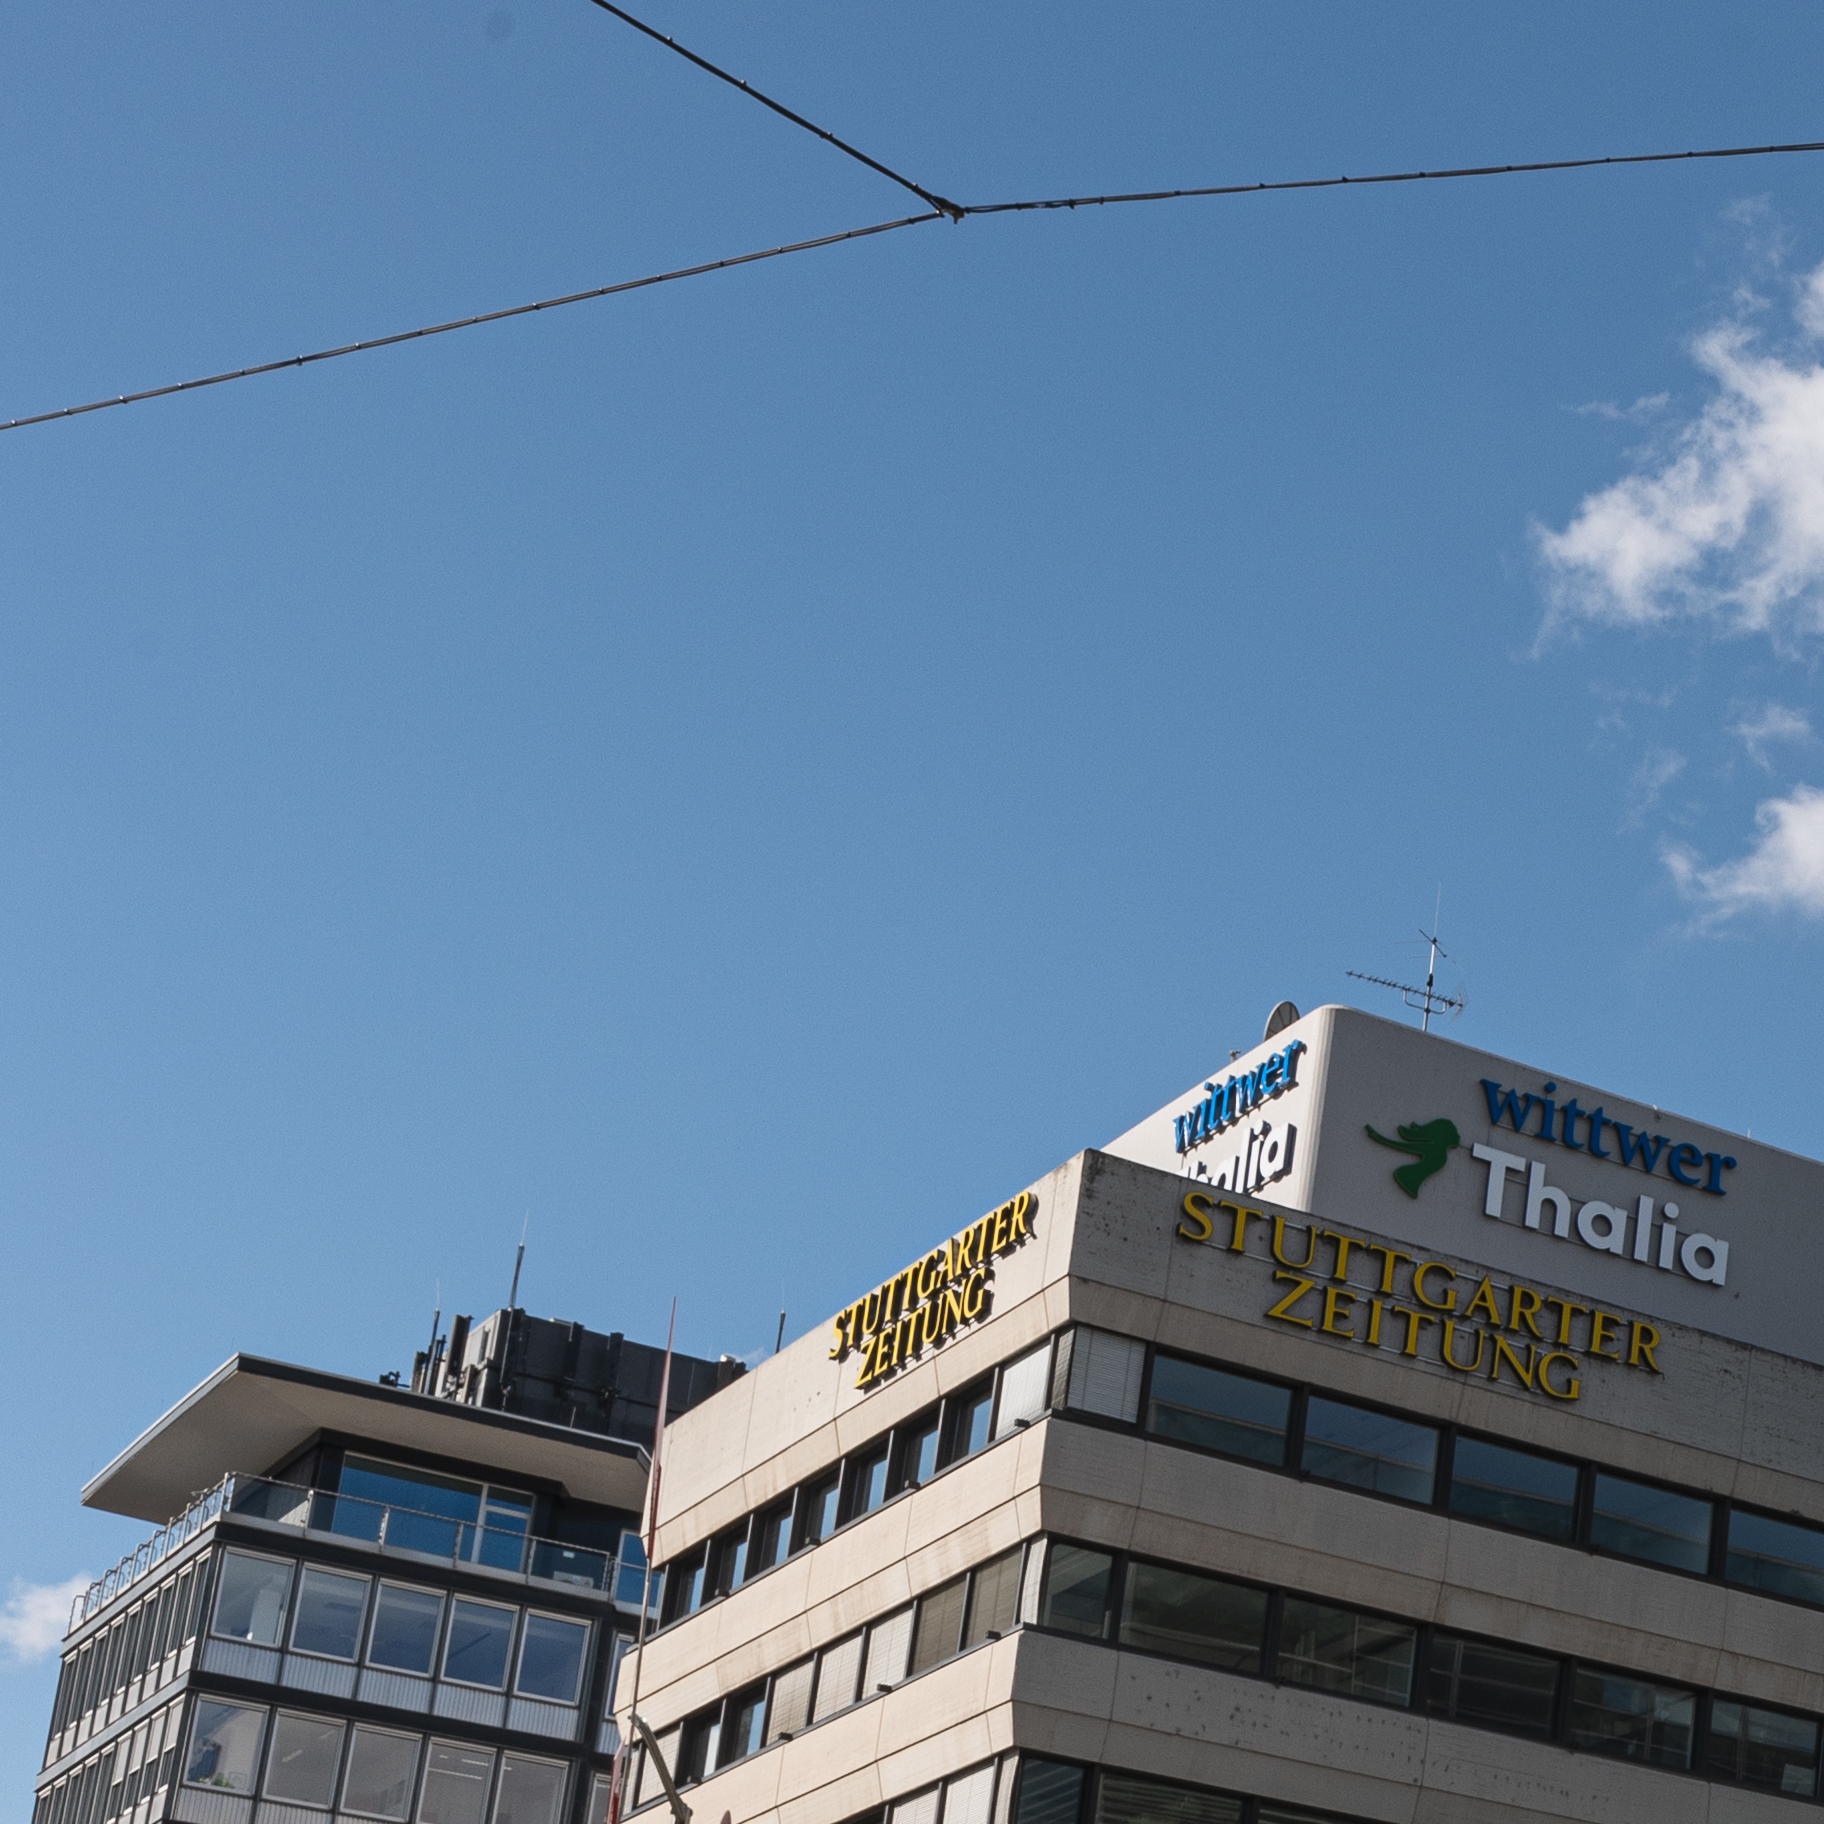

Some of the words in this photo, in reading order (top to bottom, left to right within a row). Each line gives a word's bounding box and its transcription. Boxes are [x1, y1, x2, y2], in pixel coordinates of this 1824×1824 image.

[1173, 1039, 1305, 1154] wittwer
[1480, 1077, 1736, 1195] wittwer
[829, 1190, 1038, 1363] STUTTGARTER
[1472, 1142, 1730, 1288] Thalia
[853, 1266, 996, 1392] ZEITUNG
[1177, 1190, 1664, 1375] STUTTGARTER
[1265, 1270, 1582, 1400] ZEITUNG
